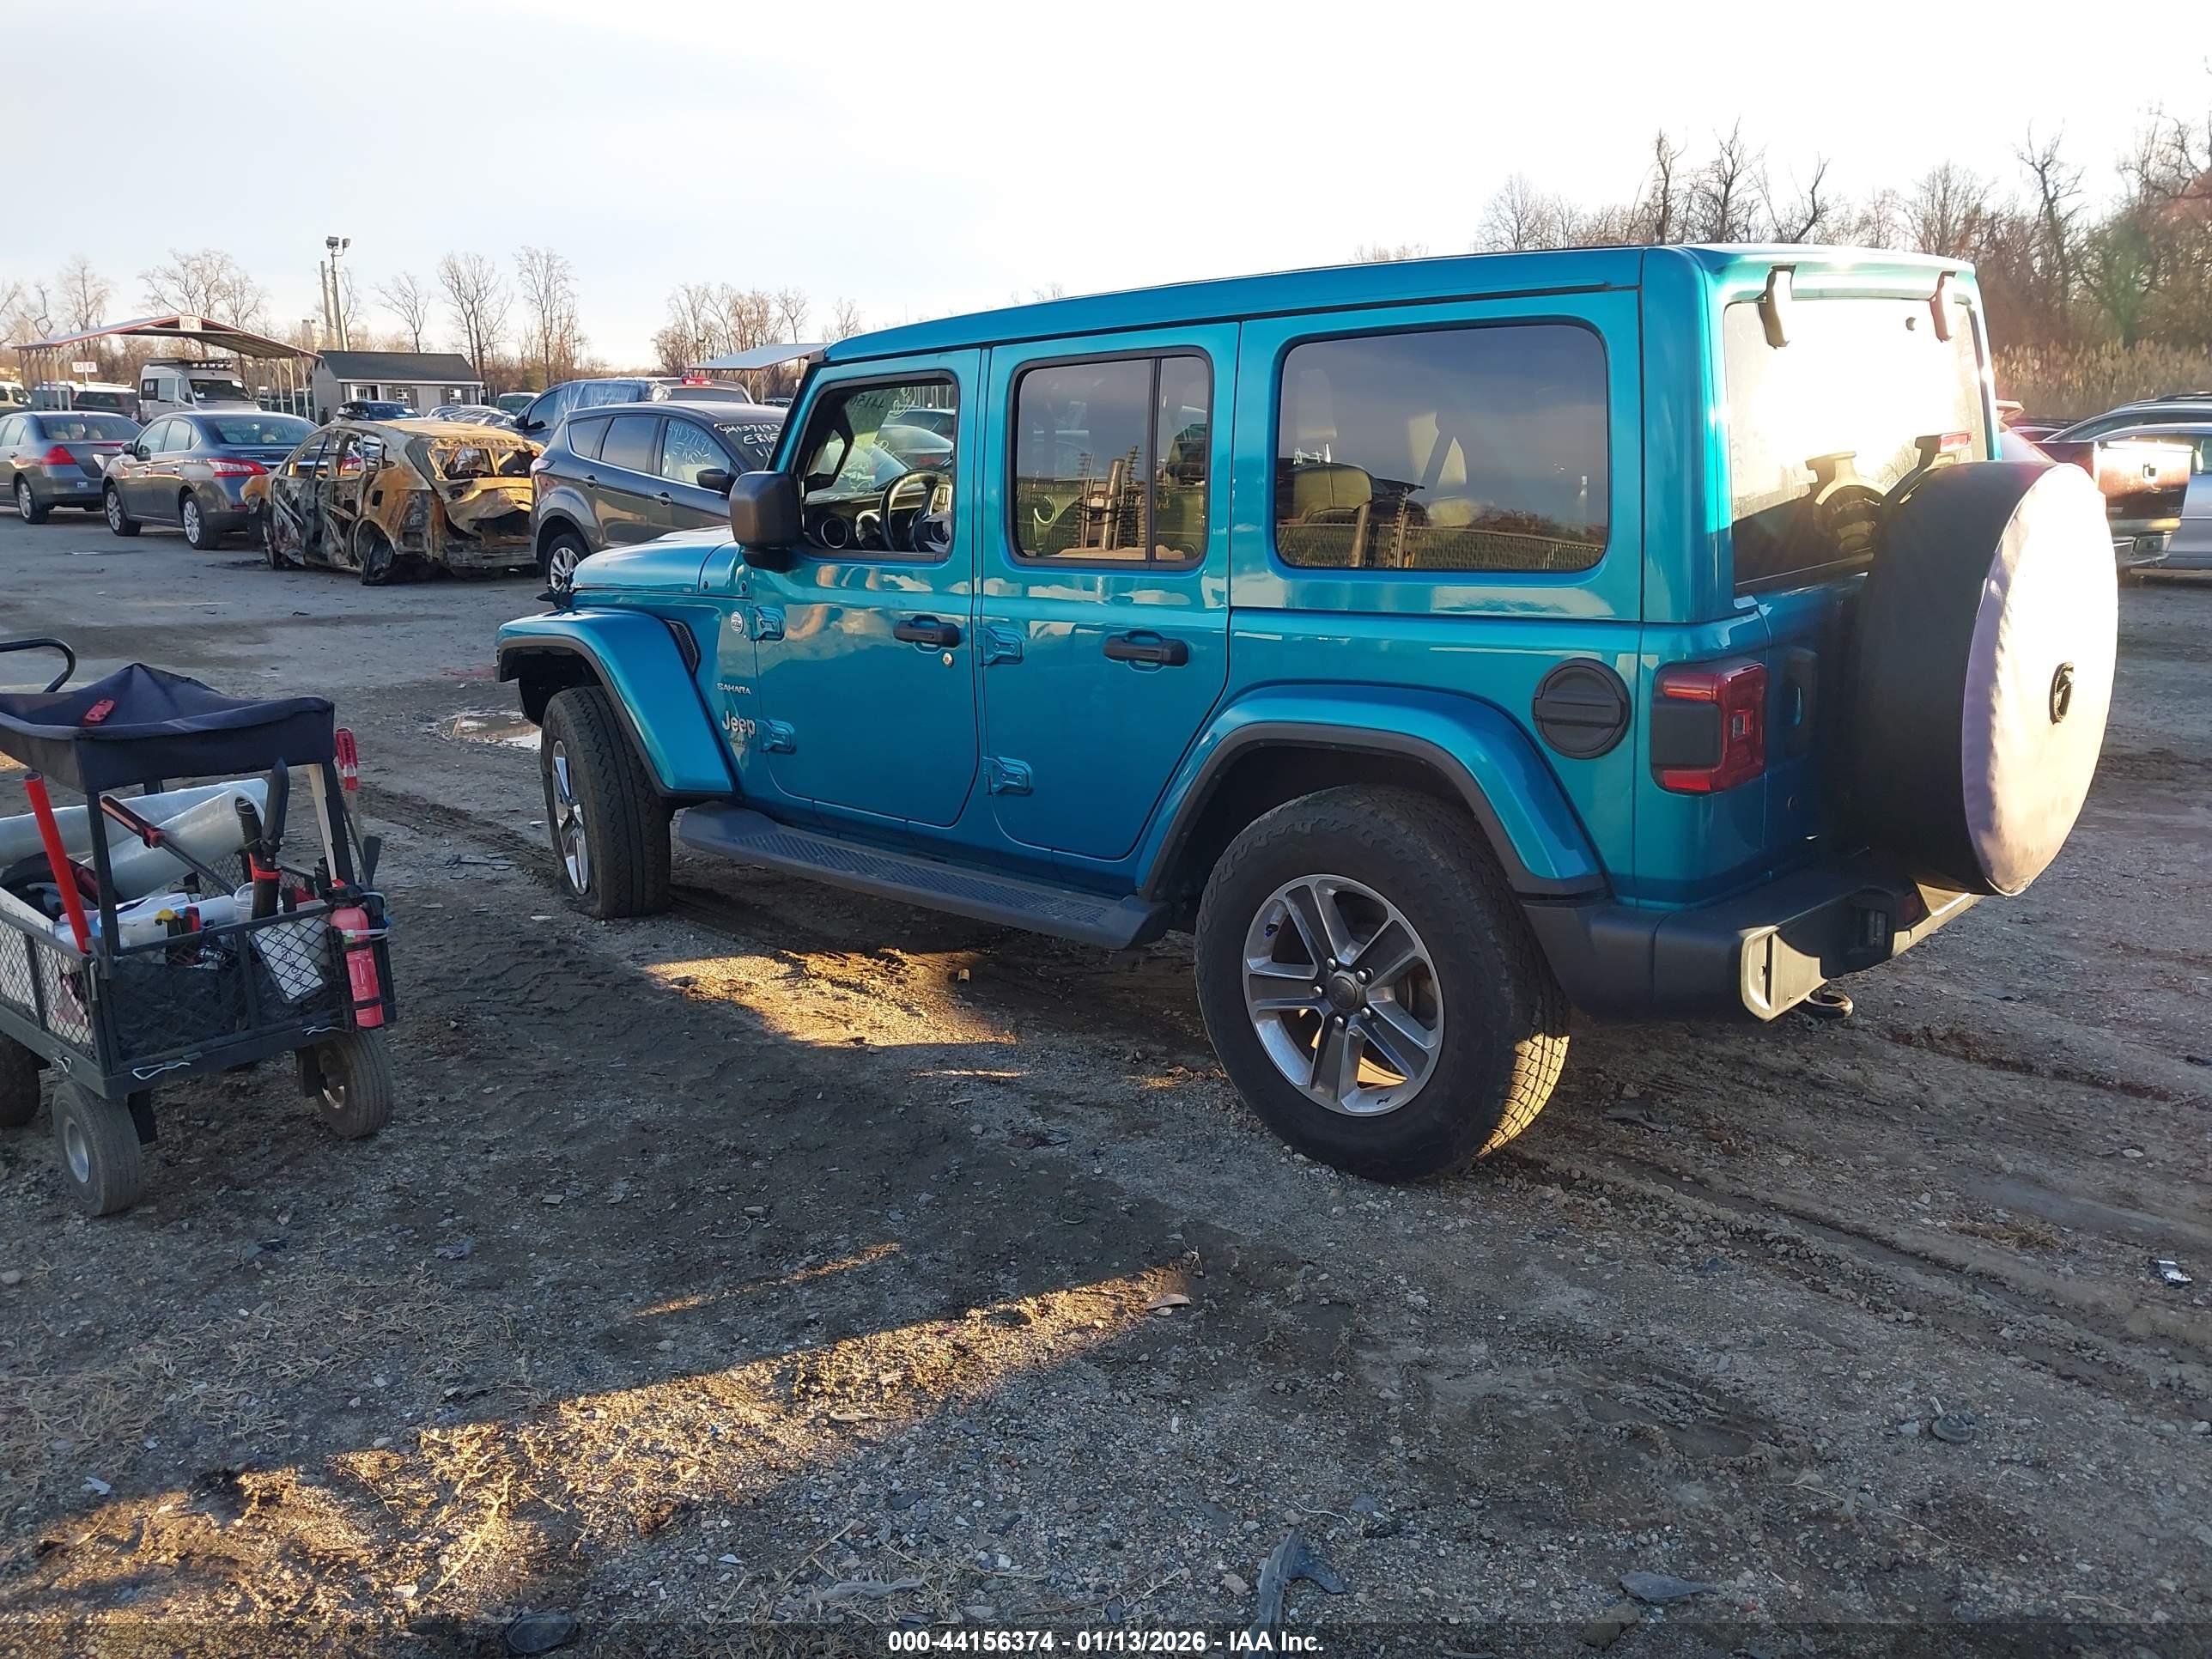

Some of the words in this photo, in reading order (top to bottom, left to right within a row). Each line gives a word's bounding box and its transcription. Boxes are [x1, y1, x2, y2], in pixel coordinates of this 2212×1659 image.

[181, 318, 194, 329] VIC
[197, 319, 201, 330] 1
[743, 433, 780, 445] ERIE
[716, 682, 752, 696] SAHARA
[721, 710, 756, 739] Jeep
